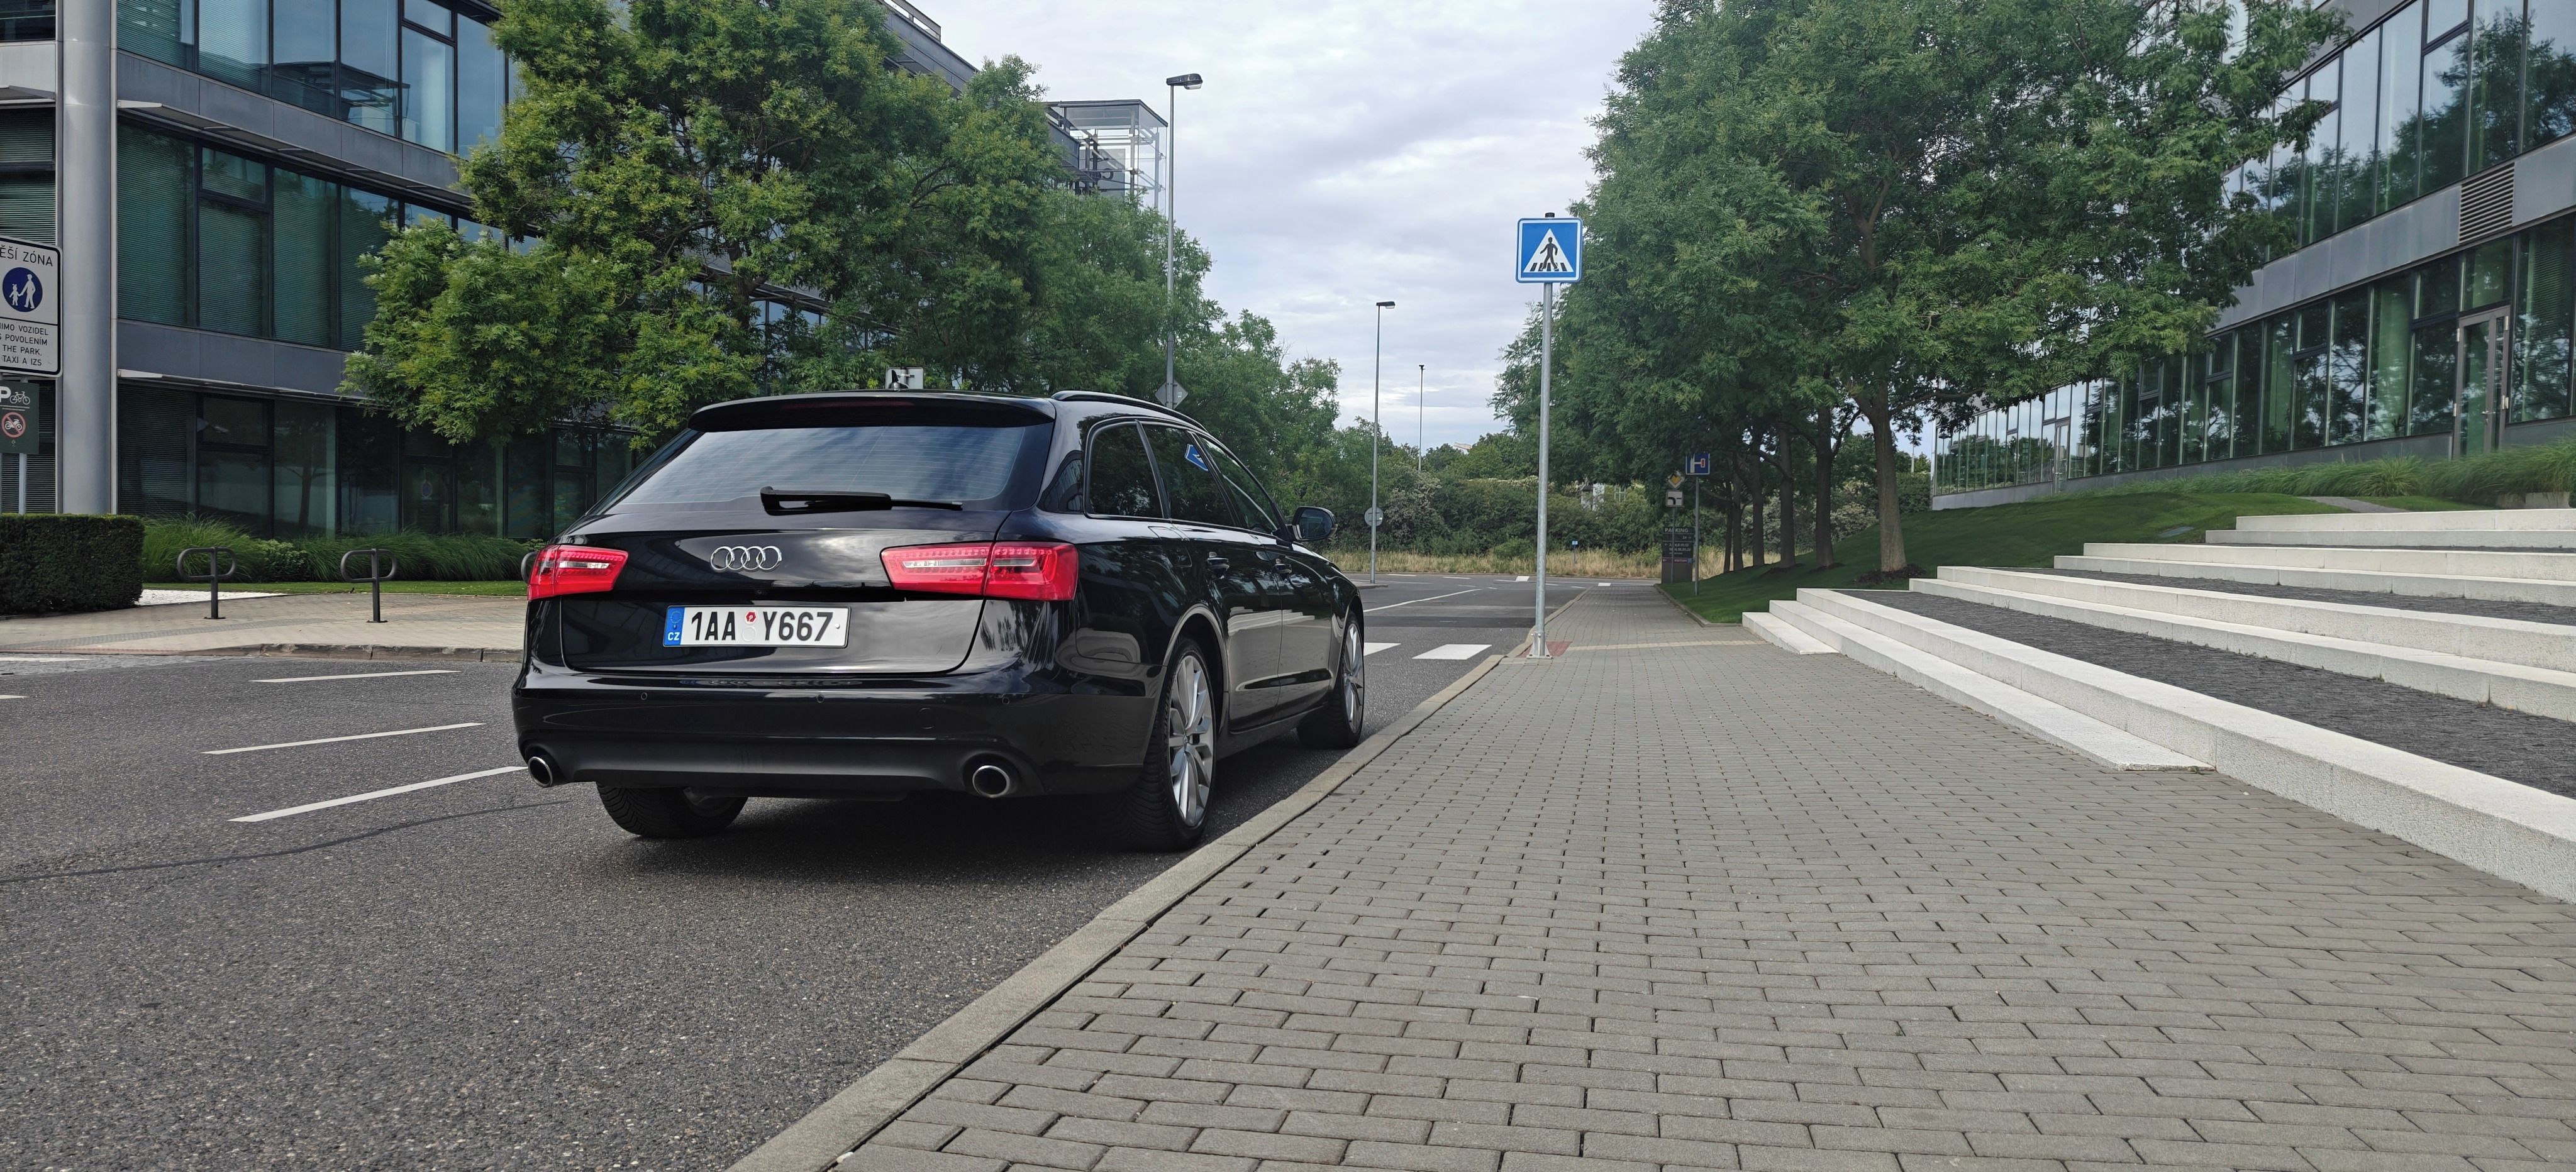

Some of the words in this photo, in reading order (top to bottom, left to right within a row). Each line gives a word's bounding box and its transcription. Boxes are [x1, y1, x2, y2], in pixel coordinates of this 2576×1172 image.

[23, 250, 53, 267] ZÓNA
[0, 323, 14, 331] IMO
[18, 325, 49, 336] VOZIDEL
[5, 334, 48, 346] POVOLENÍM
[2, 345, 17, 353] THE
[2, 355, 19, 363] TAXI
[0, 386, 11, 402] P
[667, 632, 680, 641] CZ
[691, 611, 736, 641] 1AA
[762, 611, 834, 641] Y667
